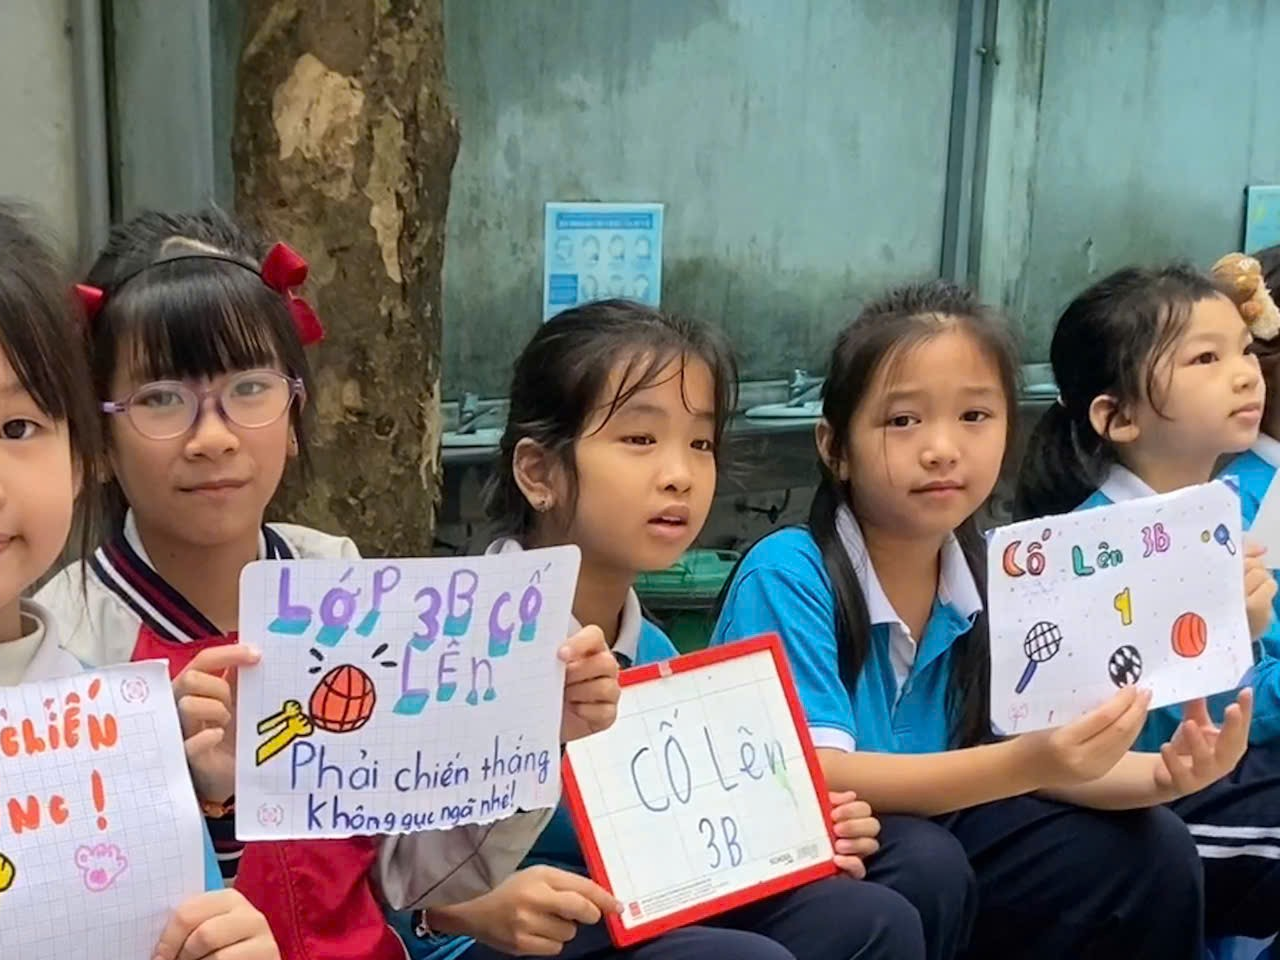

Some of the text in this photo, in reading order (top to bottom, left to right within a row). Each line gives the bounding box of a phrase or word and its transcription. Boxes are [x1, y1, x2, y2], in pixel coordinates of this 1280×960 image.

[1002, 522, 1171, 577] Cố Lên 3B
[271, 562, 552, 655] LỚP 3B CỐ
[291, 735, 551, 792] Phải chiến thắng
[630, 709, 787, 812] CỐ Lên
[307, 793, 396, 831] Không
[440, 797, 477, 827] ngã
[480, 779, 517, 817] nhé!
[698, 815, 743, 869] 3B
